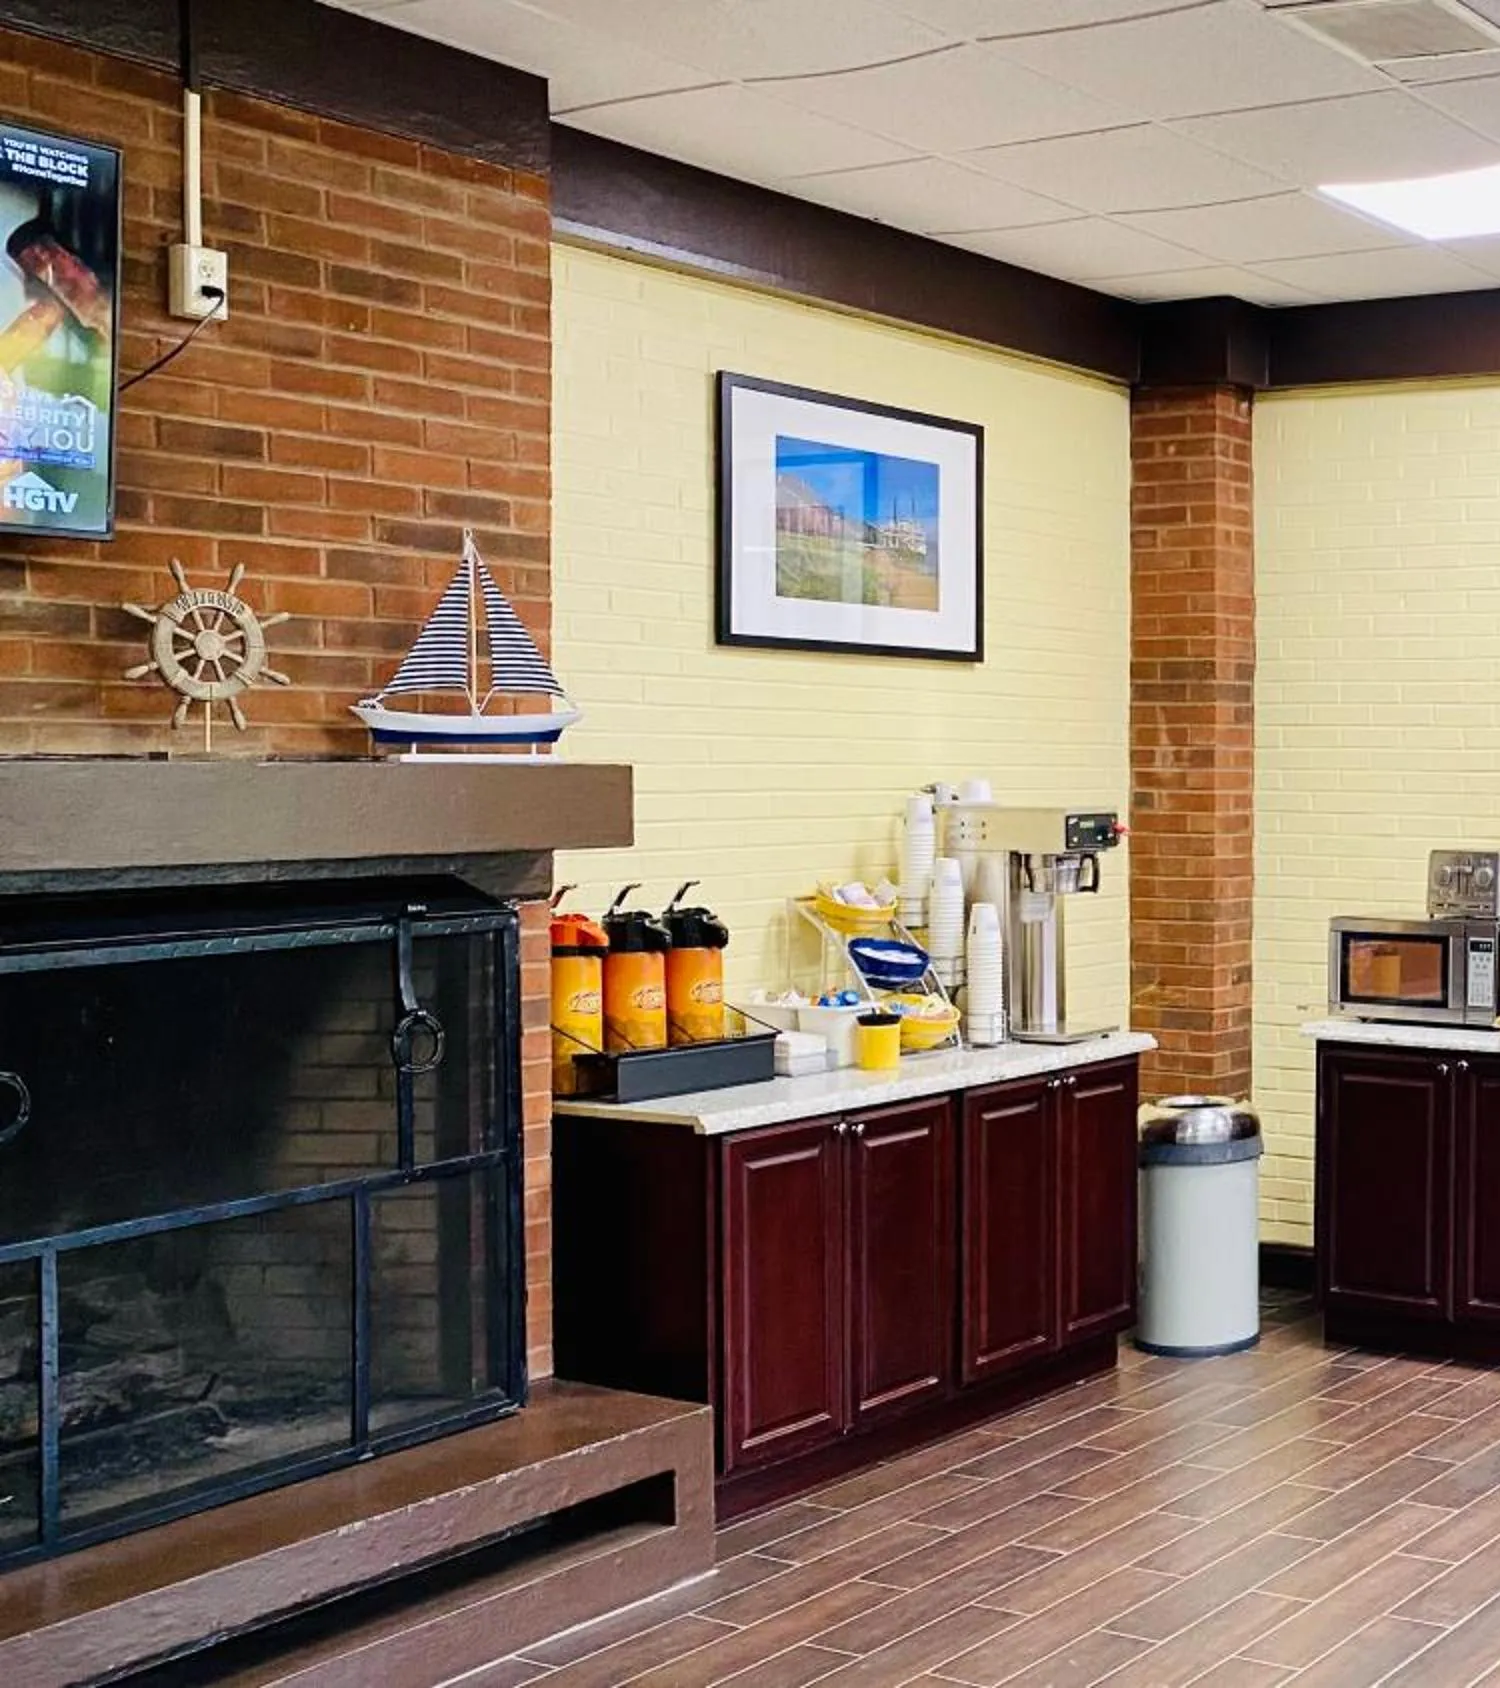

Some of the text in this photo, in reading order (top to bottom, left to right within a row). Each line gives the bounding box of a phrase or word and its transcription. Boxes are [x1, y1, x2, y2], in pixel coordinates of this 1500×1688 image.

[6, 148, 36, 165] THE
[38, 156, 88, 178] BLOCK
[4, 483, 79, 513] HGTV
